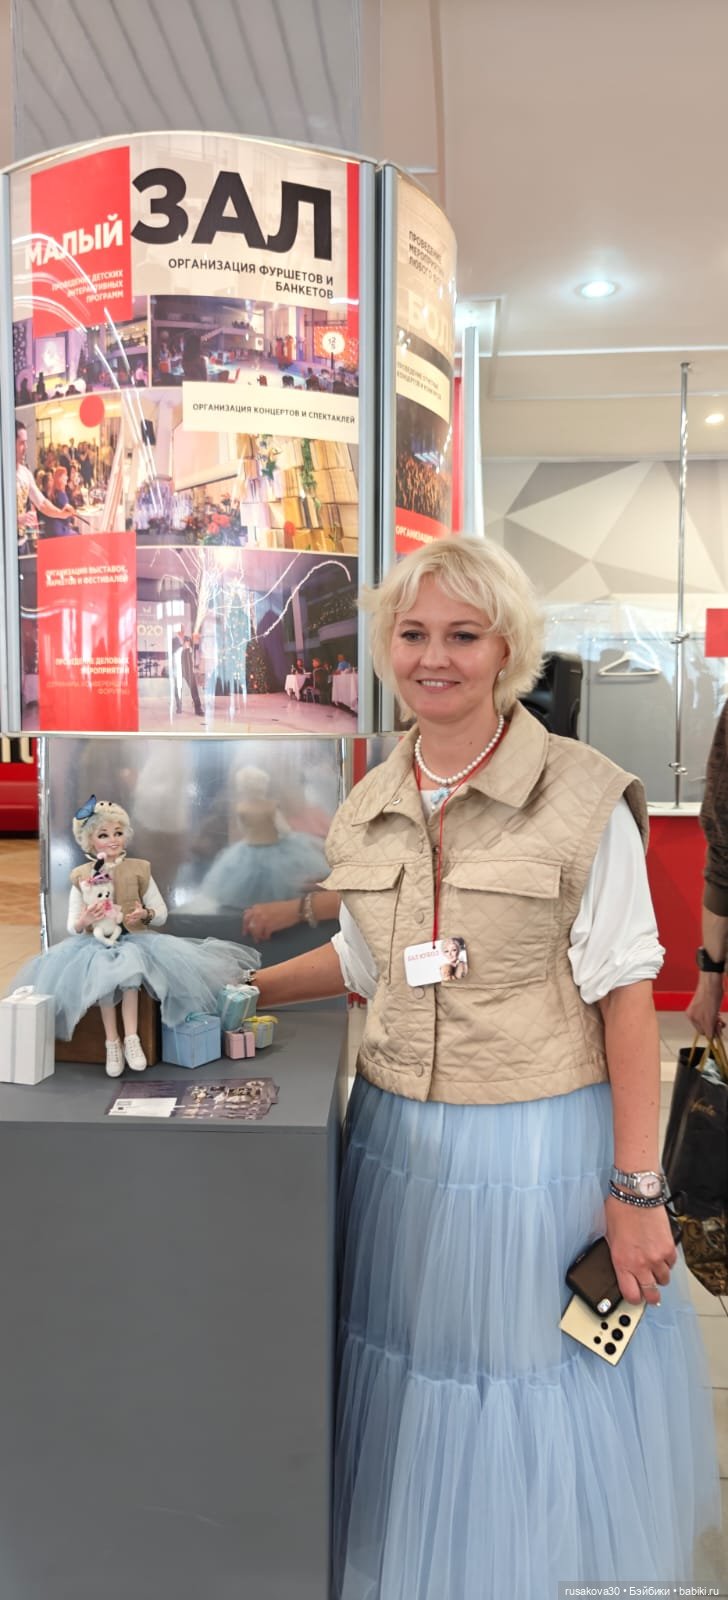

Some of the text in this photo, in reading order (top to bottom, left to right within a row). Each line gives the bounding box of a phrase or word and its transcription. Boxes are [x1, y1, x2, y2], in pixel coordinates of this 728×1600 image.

[131, 167, 332, 261] ЗАЛ
[24, 213, 124, 270] МАЛЫЙ
[168, 258, 334, 286] ОРГАНИЗАЦИЯ ФУРШЕТОВ И
[275, 281, 334, 300] БАНКЕТОВ
[192, 403, 252, 414] ОРГАНИЗАЦИЯ
[253, 406, 300, 417] КОНЦЕРТОВ
[308, 411, 356, 424] СПЕКТАКЛЕЙ
